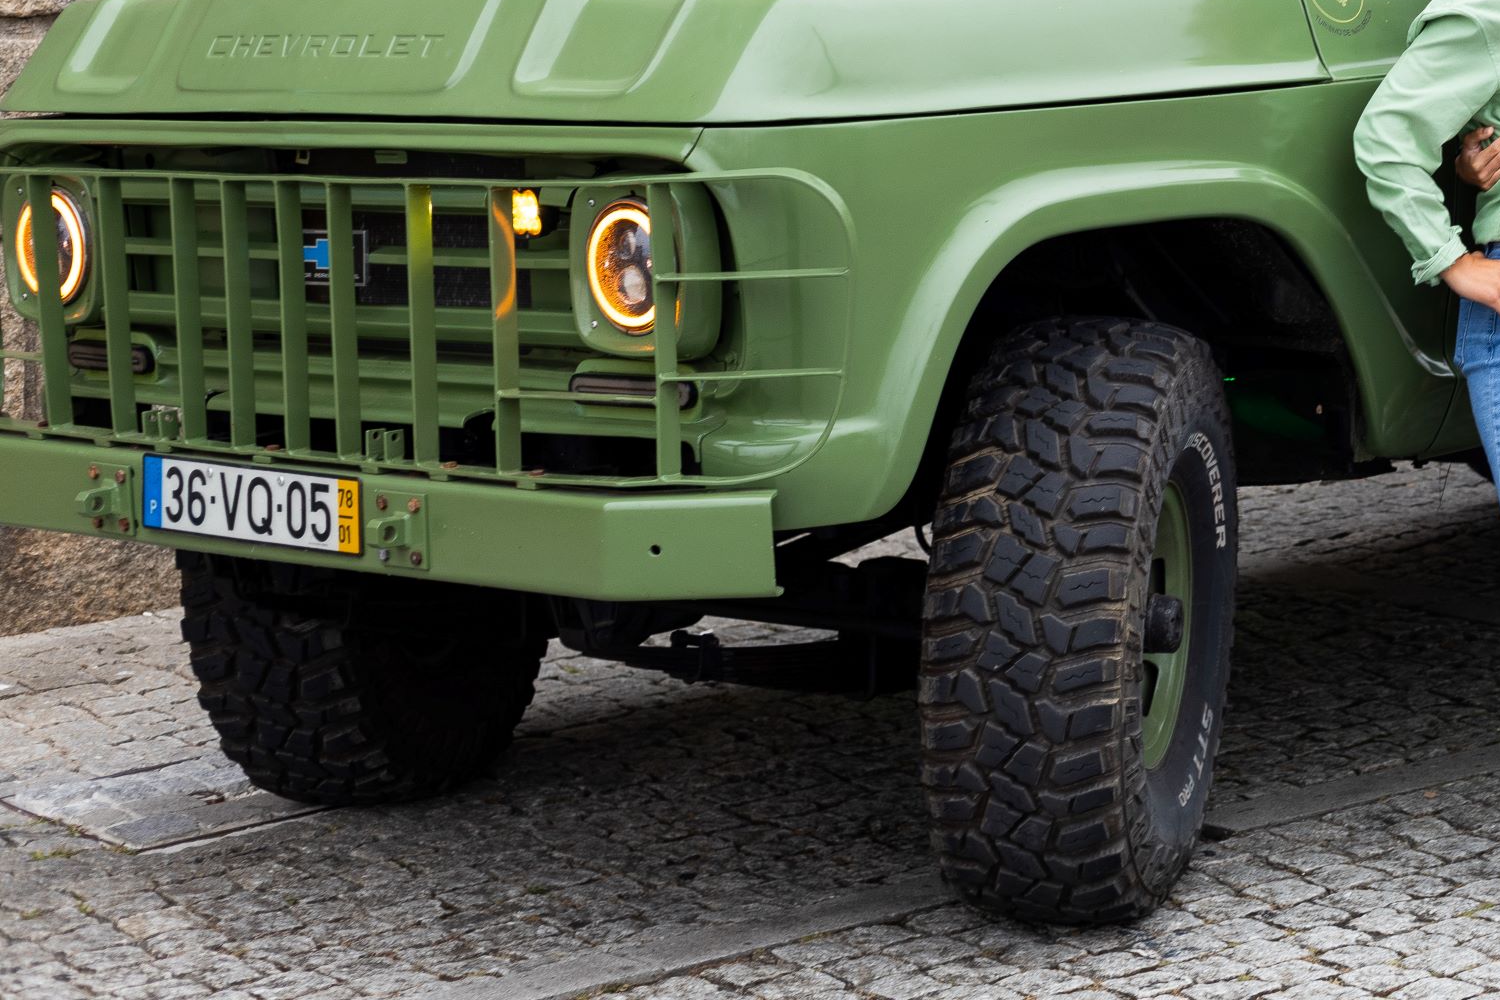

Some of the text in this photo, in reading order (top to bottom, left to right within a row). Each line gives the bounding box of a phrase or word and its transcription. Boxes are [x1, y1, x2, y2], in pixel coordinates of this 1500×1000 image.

[205, 33, 446, 59] CHEVROLET
[338, 488, 353, 509] 78
[1183, 432, 1226, 549] DISCOVERER
[150, 499, 158, 514] P
[338, 524, 352, 544] 01
[1178, 701, 1214, 808] STT PRO
